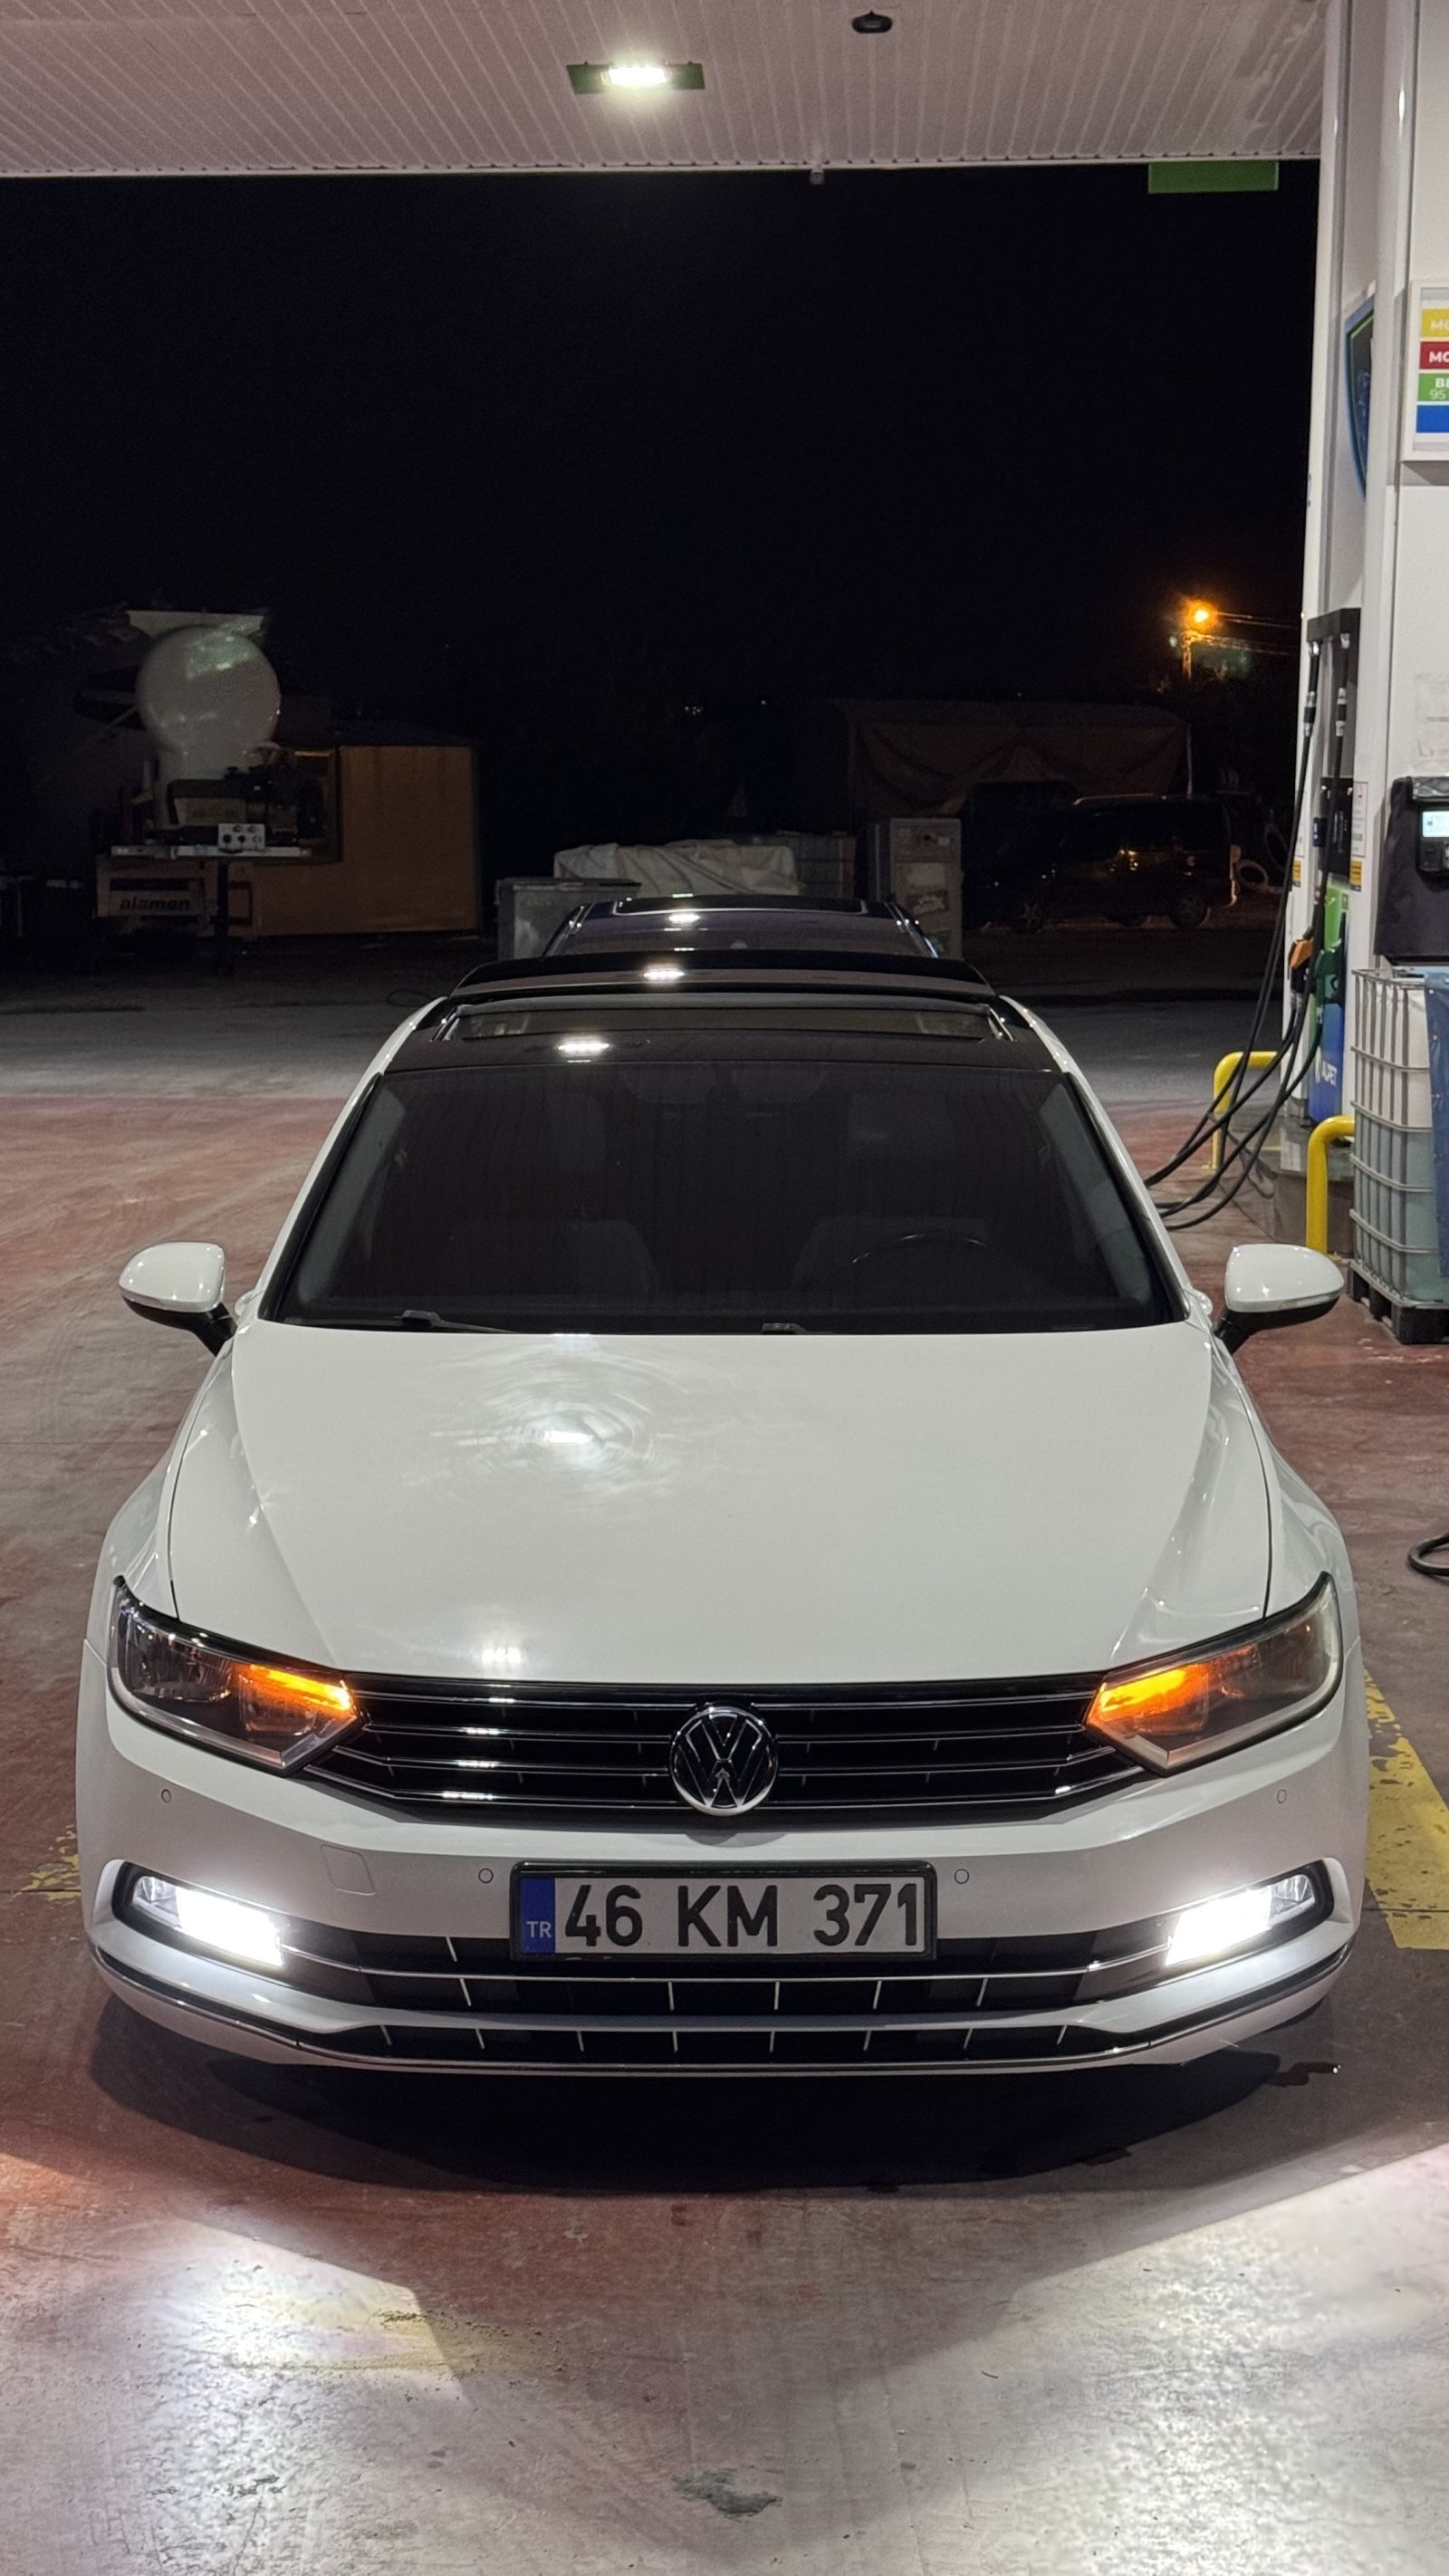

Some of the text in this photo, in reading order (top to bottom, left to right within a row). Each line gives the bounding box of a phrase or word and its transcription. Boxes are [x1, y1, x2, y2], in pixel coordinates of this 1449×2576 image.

[526, 1883, 917, 1947] TR 46 KM 371
